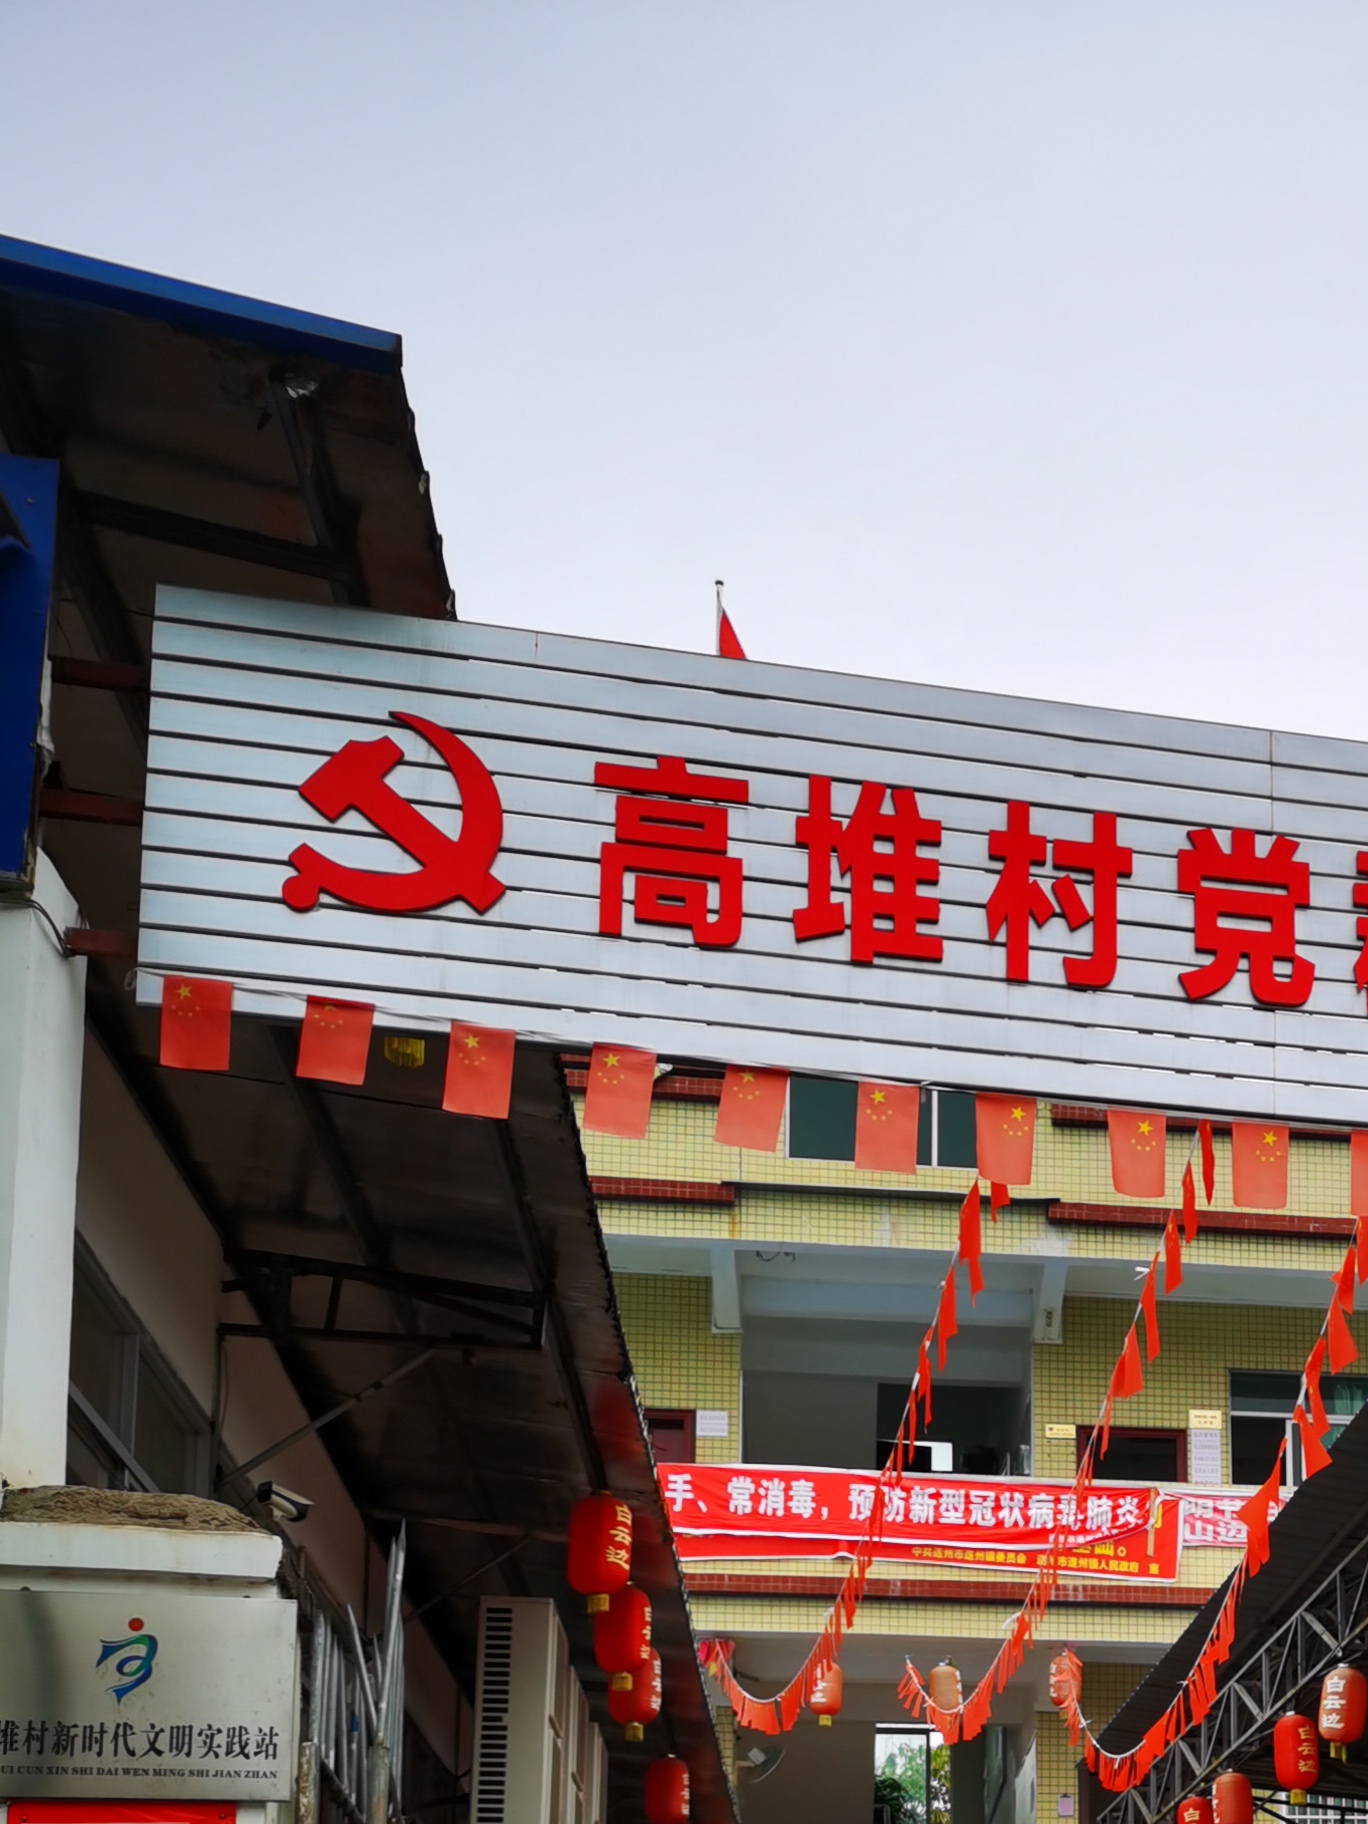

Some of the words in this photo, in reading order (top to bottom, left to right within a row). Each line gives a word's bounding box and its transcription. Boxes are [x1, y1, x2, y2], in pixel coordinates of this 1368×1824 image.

[1321, 1676, 1346, 1730] 白云边
[1298, 1725, 1317, 1773] 白云边
